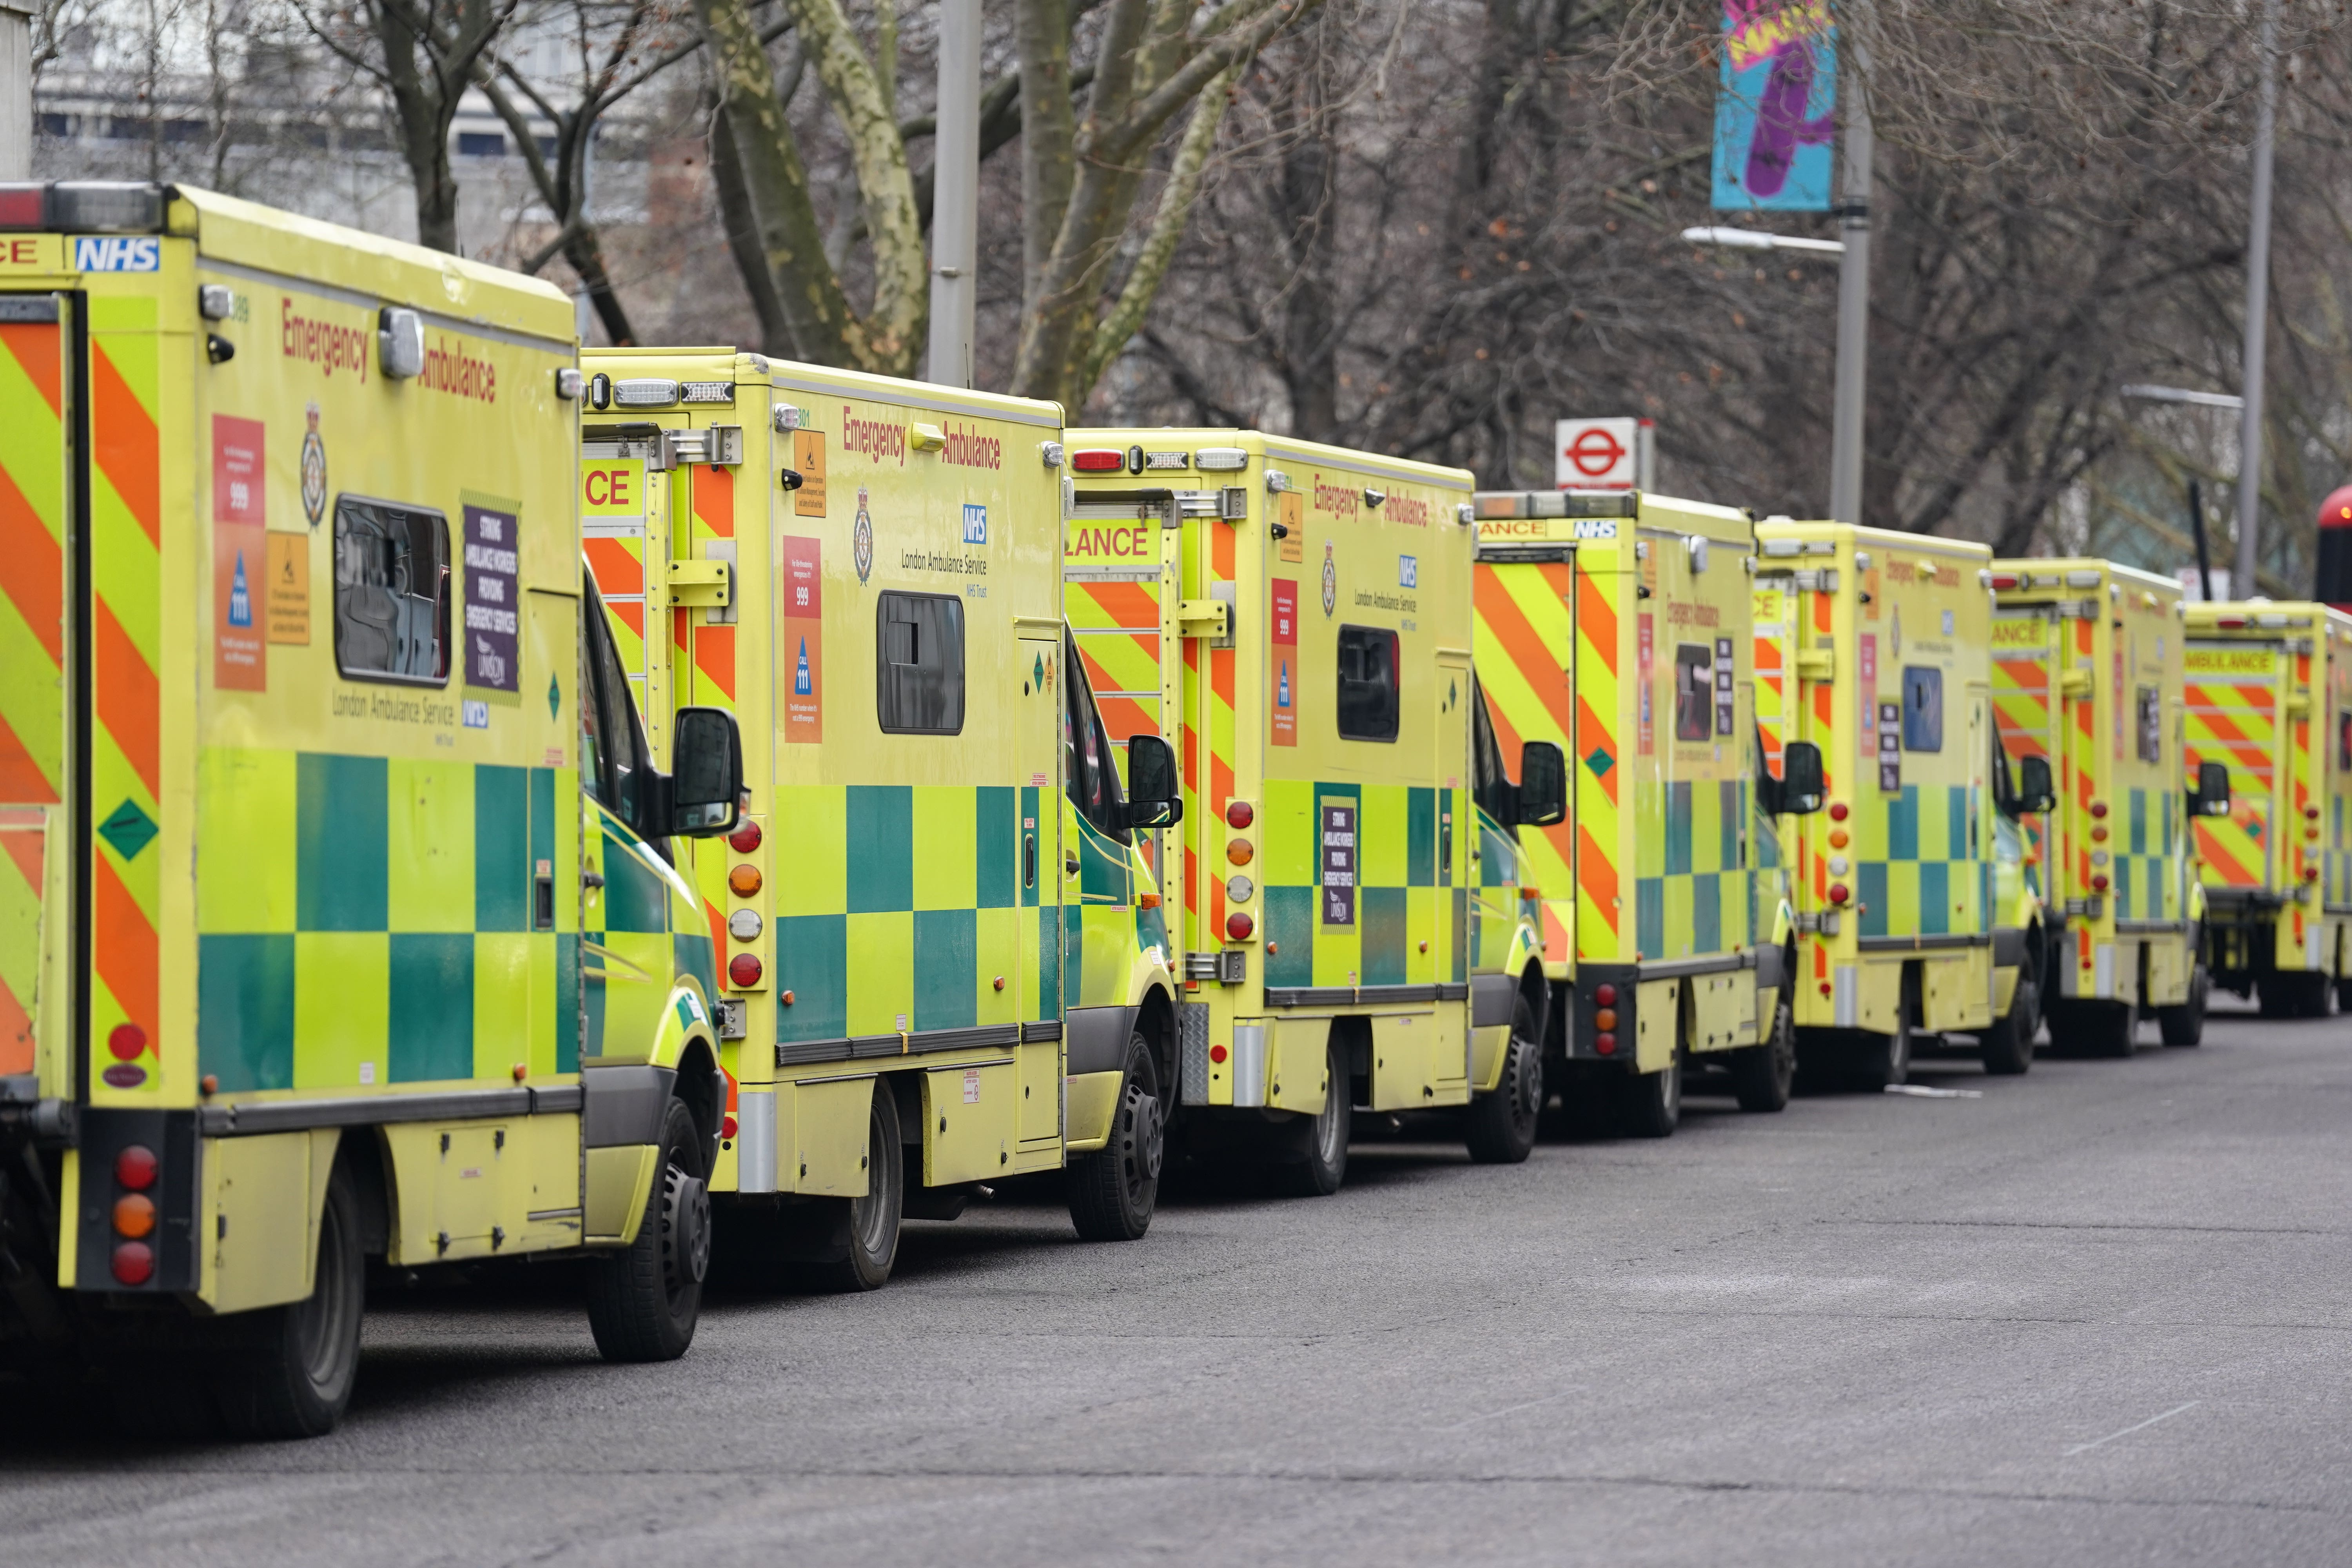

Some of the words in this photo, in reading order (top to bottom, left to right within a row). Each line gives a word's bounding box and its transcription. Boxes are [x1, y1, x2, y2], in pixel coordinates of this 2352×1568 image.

[77, 238, 159, 271] NHS
[232, 295, 249, 323] 89
[282, 298, 368, 384] Emergency
[418, 336, 495, 403] Ambulance
[843, 406, 906, 466] Emergency
[942, 421, 1000, 470] Ambulance
[230, 482, 249, 509] 999
[581, 470, 629, 505] CE
[1314, 473, 1358, 523] Emergency
[1385, 486, 1426, 527] Ambulance
[479, 515, 502, 542] STRIKING
[963, 507, 985, 542] NHS
[1480, 521, 1544, 535] ANCE
[1573, 520, 1615, 538] NHS
[465, 543, 493, 571] AMBULANCE
[493, 548, 517, 575] WORKERS
[902, 548, 926, 570] London
[928, 550, 963, 574] Ambulance
[965, 554, 986, 575] Service
[1399, 557, 1416, 586] NHS
[797, 586, 808, 606] 999
[967, 584, 976, 597] NHS
[976, 584, 987, 598] Trust
[1355, 588, 1372, 606] London
[1373, 591, 1399, 610] Ambulance
[1400, 595, 1416, 613] Service
[466, 604, 494, 631] EMERGENCY
[494, 609, 517, 635] SERVICES
[1667, 592, 1693, 630] Emergency
[1693, 596, 1719, 629] Ambulance
[1280, 619, 1289, 635] 999
[478, 653, 505, 681] UNISON
[799, 656, 807, 664] CALL
[798, 669, 808, 689] 111
[332, 688, 366, 717] London
[370, 690, 419, 723] Ambulance
[423, 696, 454, 726] Service
[1333, 811, 1345, 827] STRIKING
[1324, 831, 1340, 847] AMBULANCE
[1340, 832, 1353, 848] WORKERS
[1331, 851, 1347, 867] PROVIDING
[1324, 871, 1340, 886] EMERGENCY
[1340, 872, 1353, 887] SERVICES
[1330, 902, 1347, 918] UNISON
